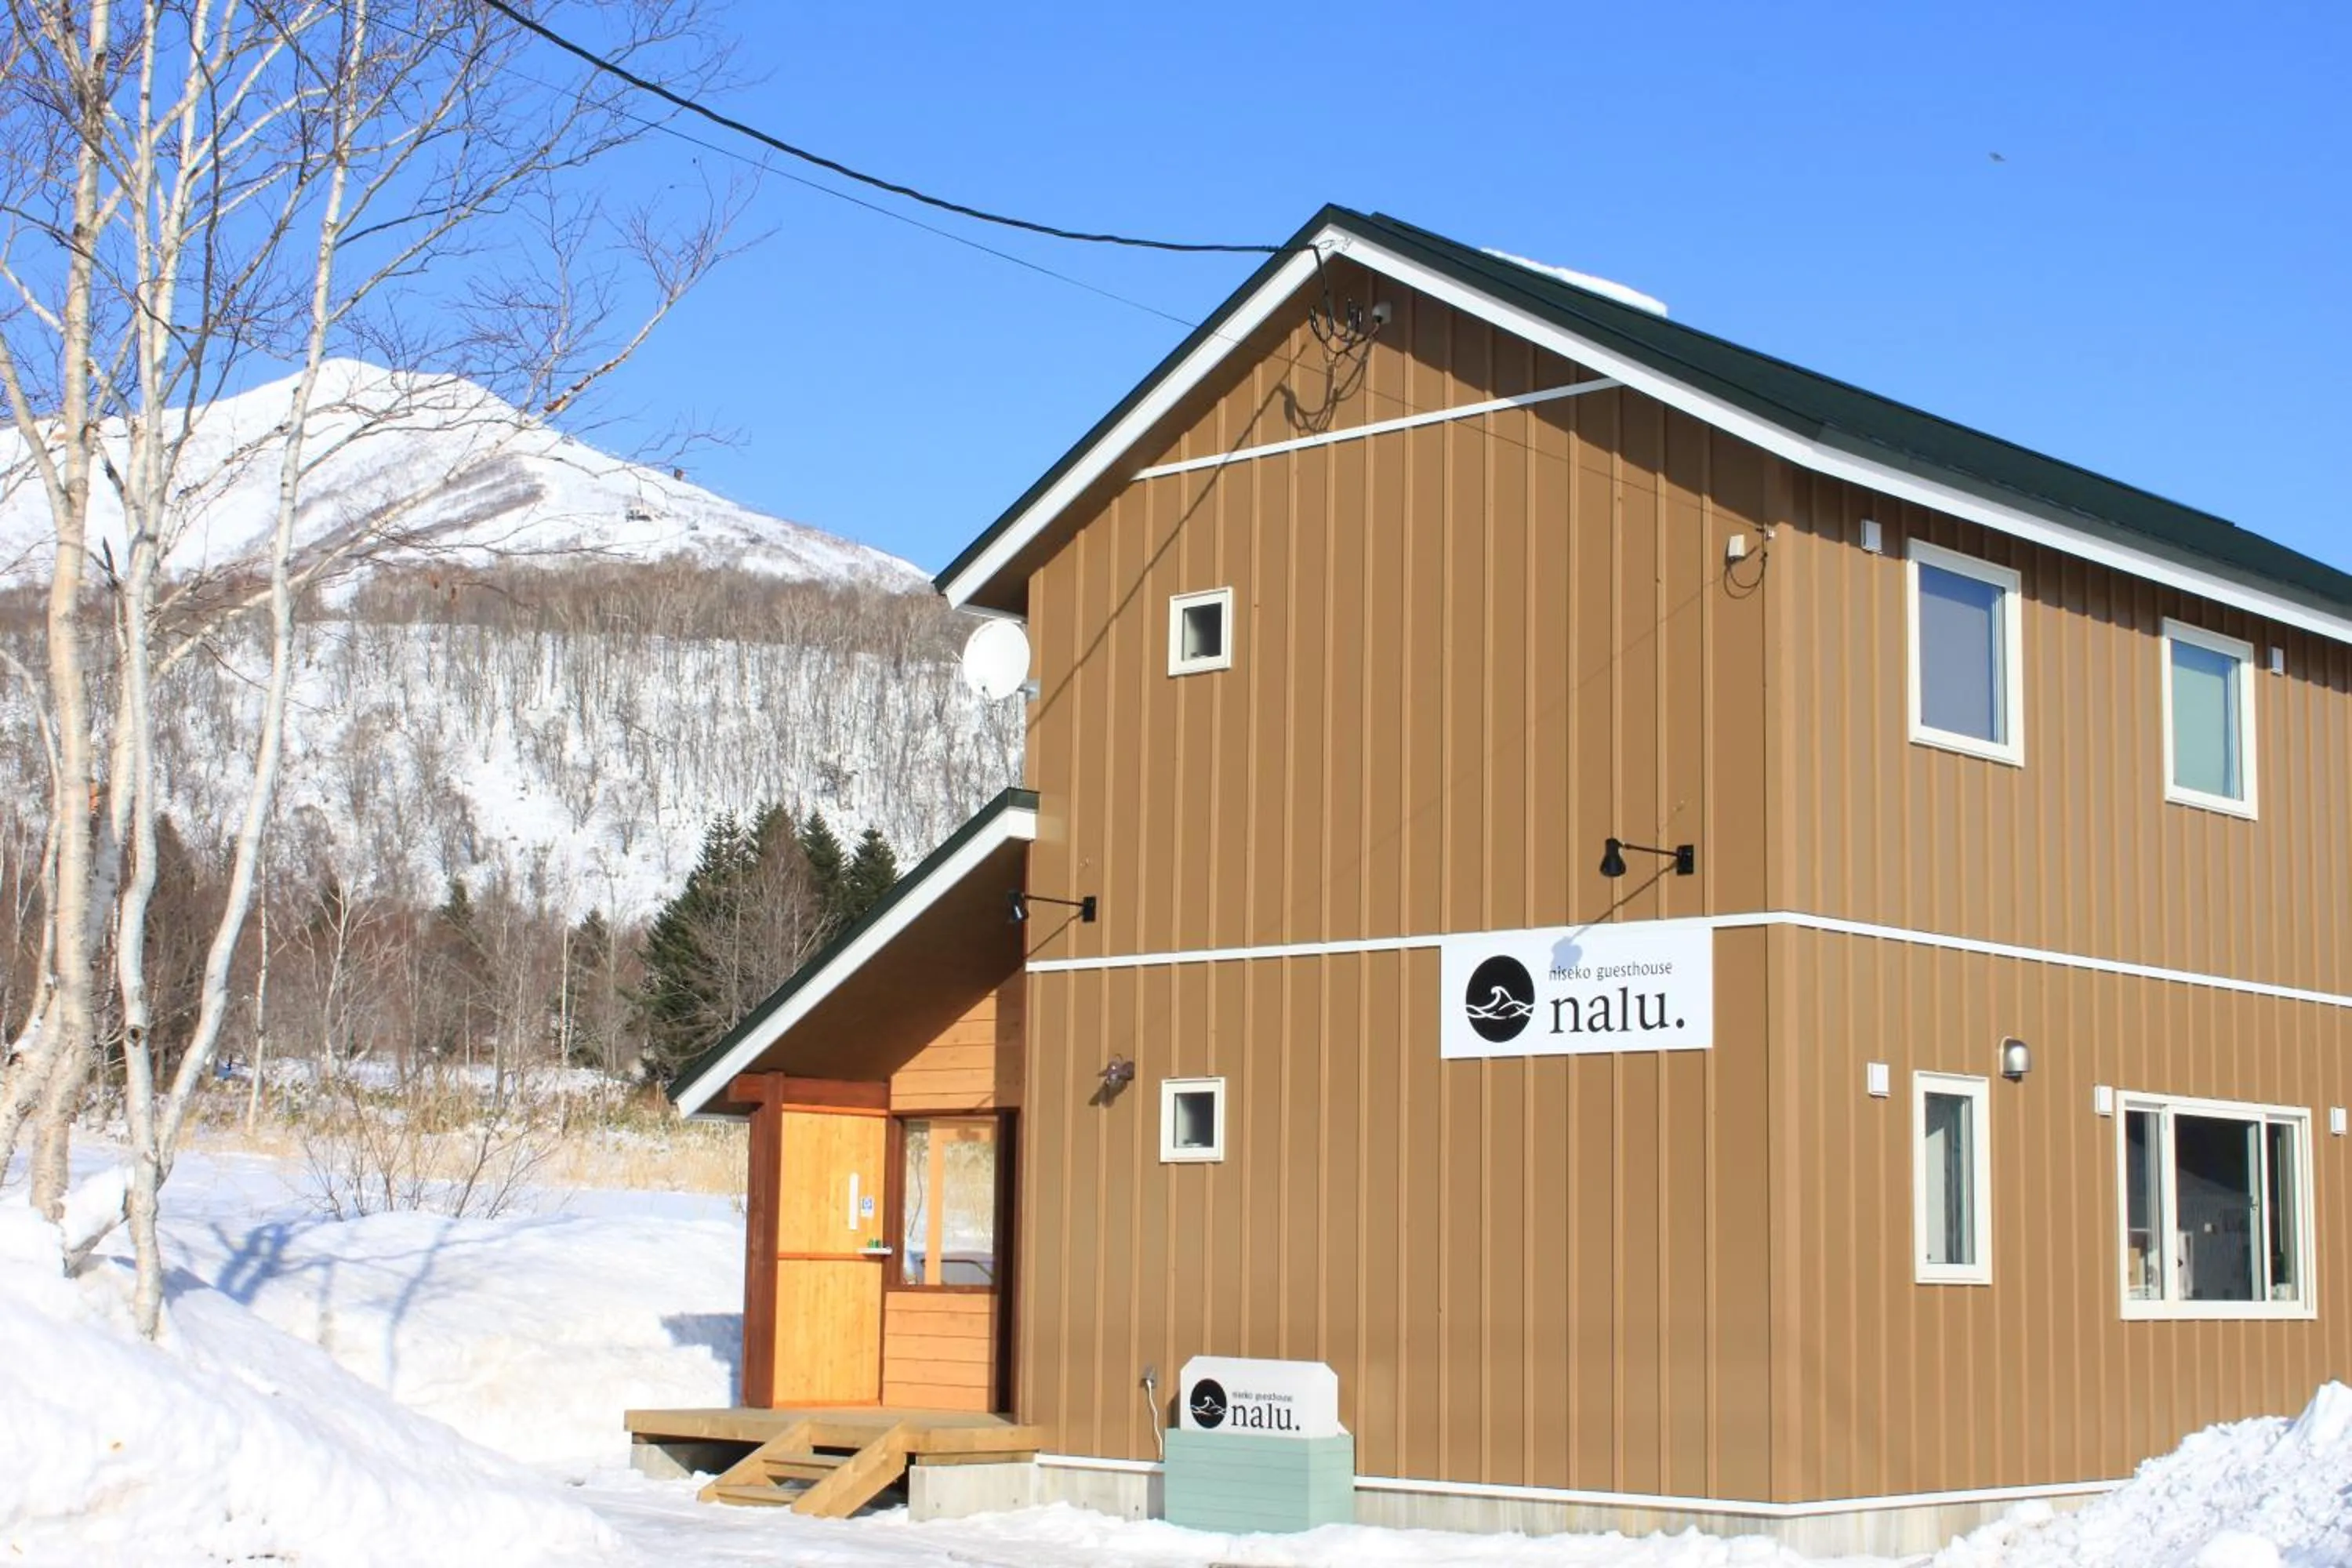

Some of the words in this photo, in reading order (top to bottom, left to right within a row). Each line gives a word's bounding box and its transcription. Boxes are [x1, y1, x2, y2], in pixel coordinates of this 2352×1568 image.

[1549, 966, 1591, 981] niseko
[1596, 961, 1673, 981] guesthouse
[1549, 986, 1685, 1034] nalu.
[1231, 1403, 1301, 1431] nalu.
